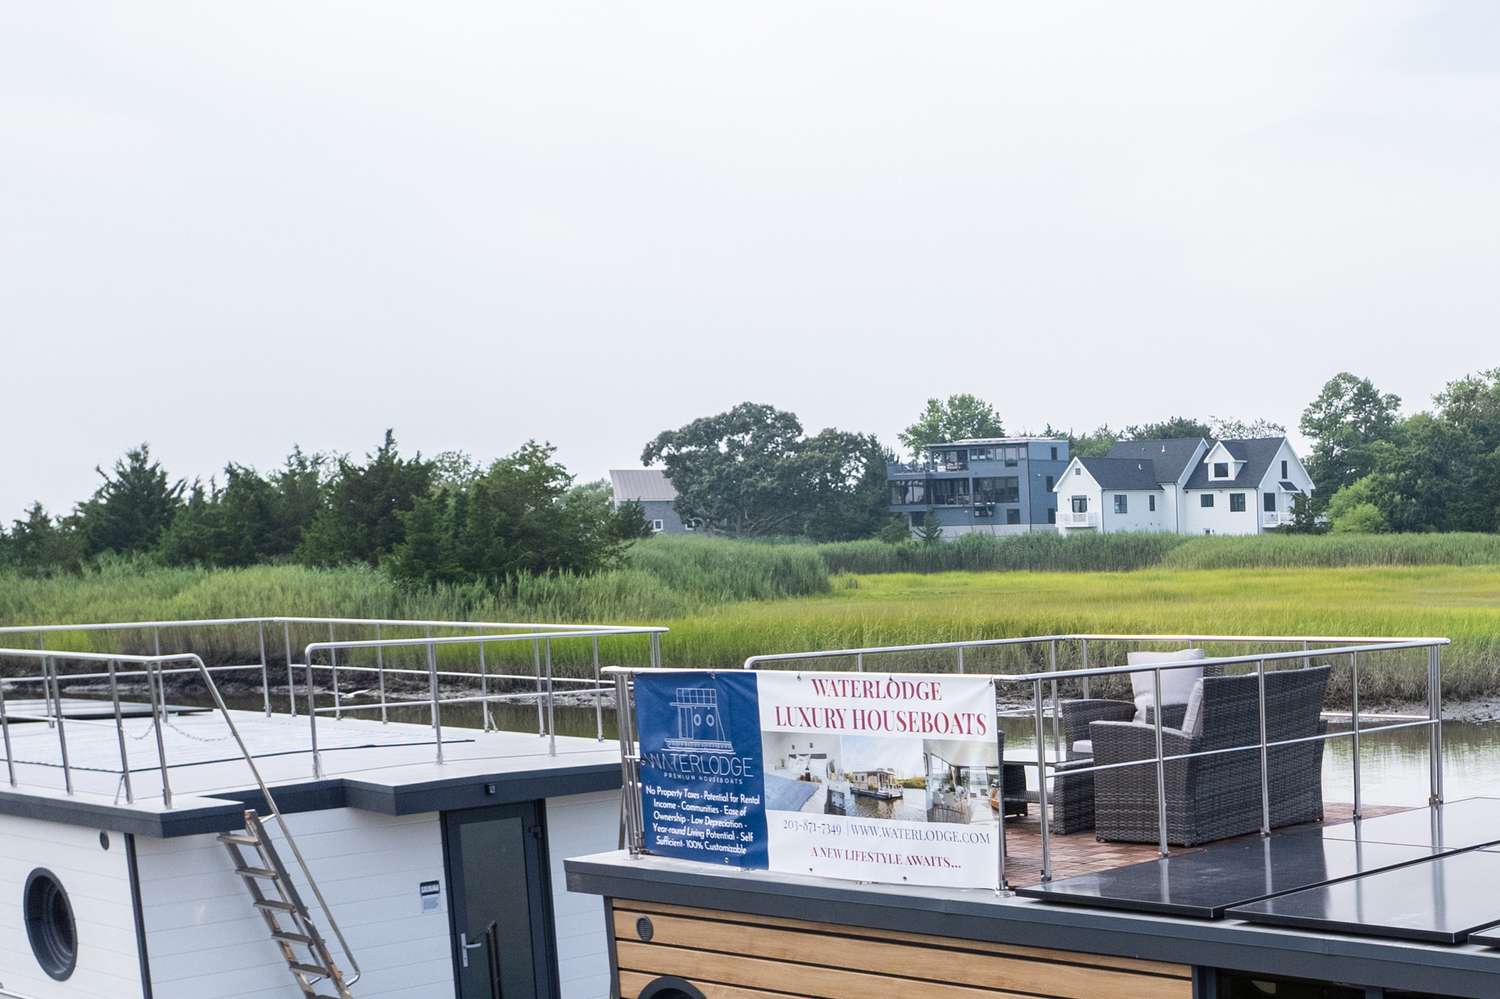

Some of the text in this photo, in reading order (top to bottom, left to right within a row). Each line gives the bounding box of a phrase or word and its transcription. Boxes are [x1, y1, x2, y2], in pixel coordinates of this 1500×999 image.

[811, 679, 943, 701] WATERLODGE
[775, 706, 987, 736] LUXURY HOUSEBOATS
[643, 753, 754, 778] WATERLODGE
[663, 772, 743, 785] PREMIUM HOUSEBOATS
[645, 785, 656, 795] No
[656, 786, 683, 799] Property
[683, 788, 700, 799] Taxes
[703, 790, 729, 802] Potential
[729, 793, 739, 803] for
[740, 794, 760, 805] Rental
[653, 799, 677, 809] Income
[681, 801, 719, 814] Communities
[723, 805, 739, 816] Ease
[739, 807, 747, 817] of
[653, 810, 686, 824] Ownership
[691, 815, 703, 825] Low
[704, 816, 744, 829] Depreciation
[652, 822, 686, 836] Year-round
[686, 826, 705, 839] Living
[705, 829, 735, 841] Potential
[740, 832, 754, 842] Self
[783, 819, 991, 844] 203-871-7349 WWW.WATERLODGE.COM
[686, 840, 704, 850] 100%
[704, 841, 747, 855] Customizable
[811, 847, 962, 868] A NEW LIFESTYLE AWAITS...
